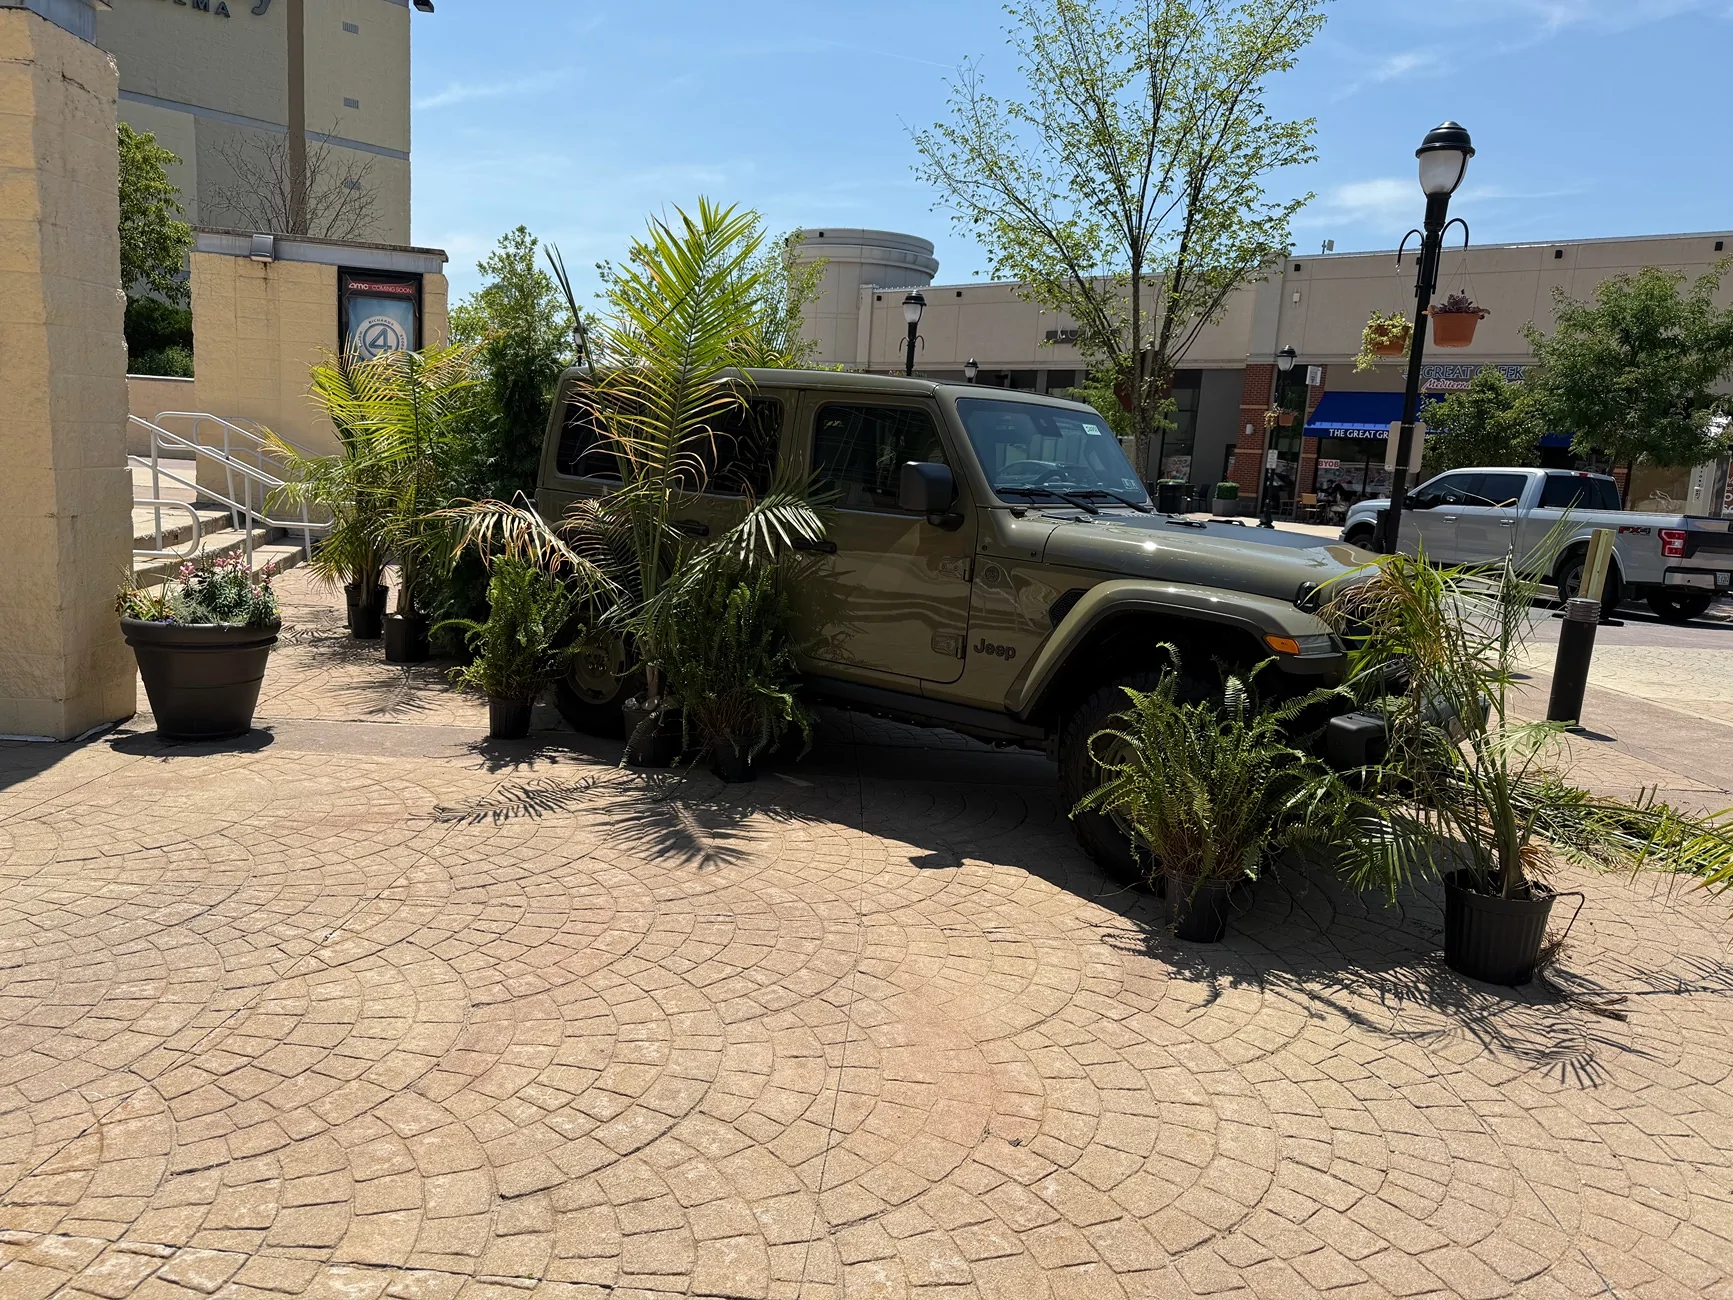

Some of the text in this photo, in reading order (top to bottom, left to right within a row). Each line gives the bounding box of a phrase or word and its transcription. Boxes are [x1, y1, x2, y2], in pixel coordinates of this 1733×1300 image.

[368, 327, 393, 352] 4
[1423, 365, 1474, 379] GREAT
[1329, 429, 1345, 437] THE
[1347, 430, 1374, 438] GREAT
[1318, 459, 1340, 468] BYOB
[1618, 526, 1652, 534] FX4
[973, 638, 1017, 661] Jeep
